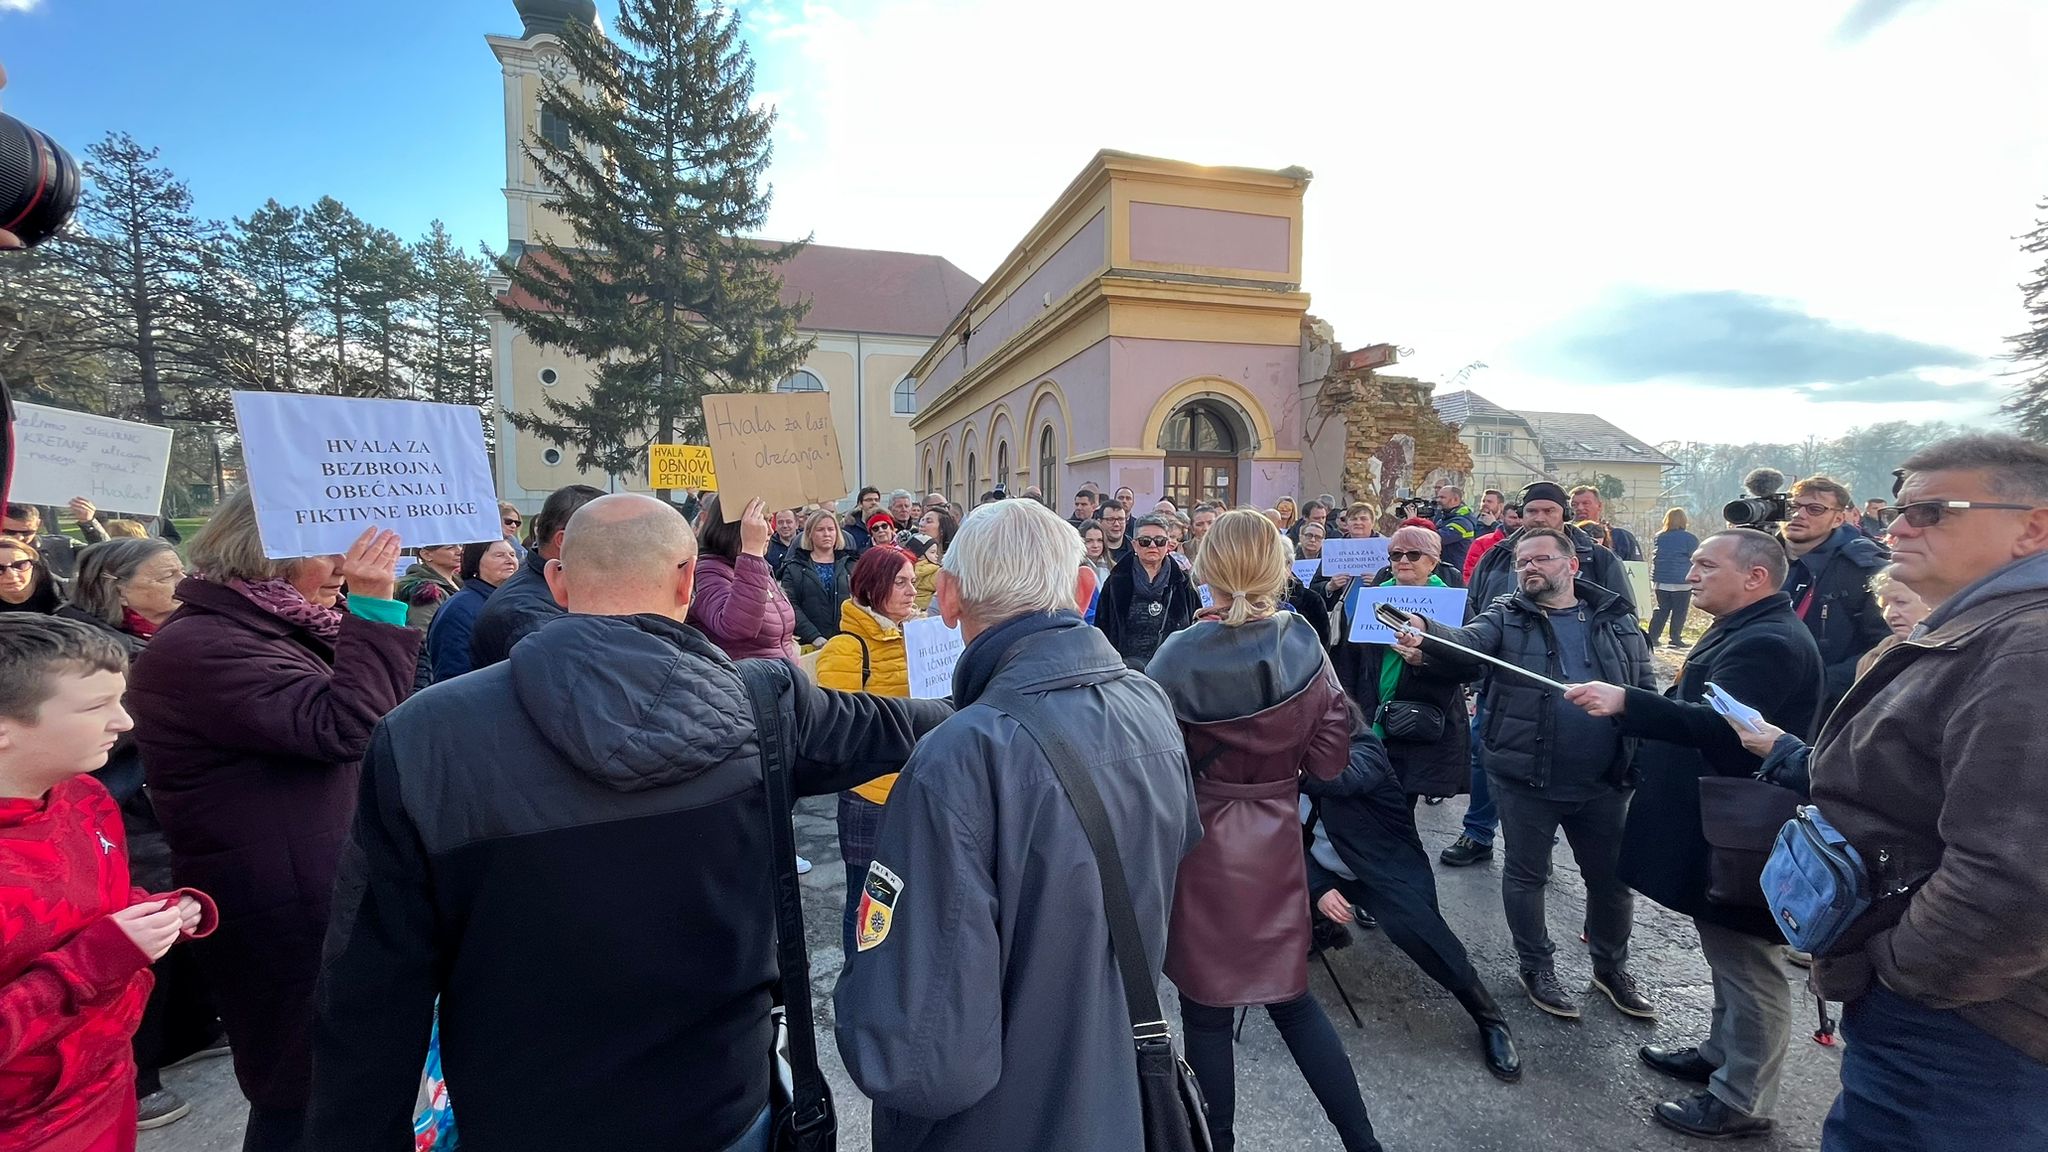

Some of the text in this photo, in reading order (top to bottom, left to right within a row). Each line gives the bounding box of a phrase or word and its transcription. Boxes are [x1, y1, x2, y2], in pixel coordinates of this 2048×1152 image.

[712, 400, 776, 441] Hvala
[784, 417, 802, 431] za
[326, 439, 431, 454] HVALA ZA
[654, 447, 707, 459] HVALA ZA
[658, 458, 716, 475] OBNOVU
[731, 450, 737, 470] i
[320, 461, 443, 477] BEZBROJNA
[659, 472, 708, 489] PETRINJE
[91, 479, 151, 500] Hvala!
[325, 480, 448, 500] OBEĆANJA I
[295, 502, 478, 525] FIKTIVNE BROJKE
[1386, 596, 1417, 604] HVALA
